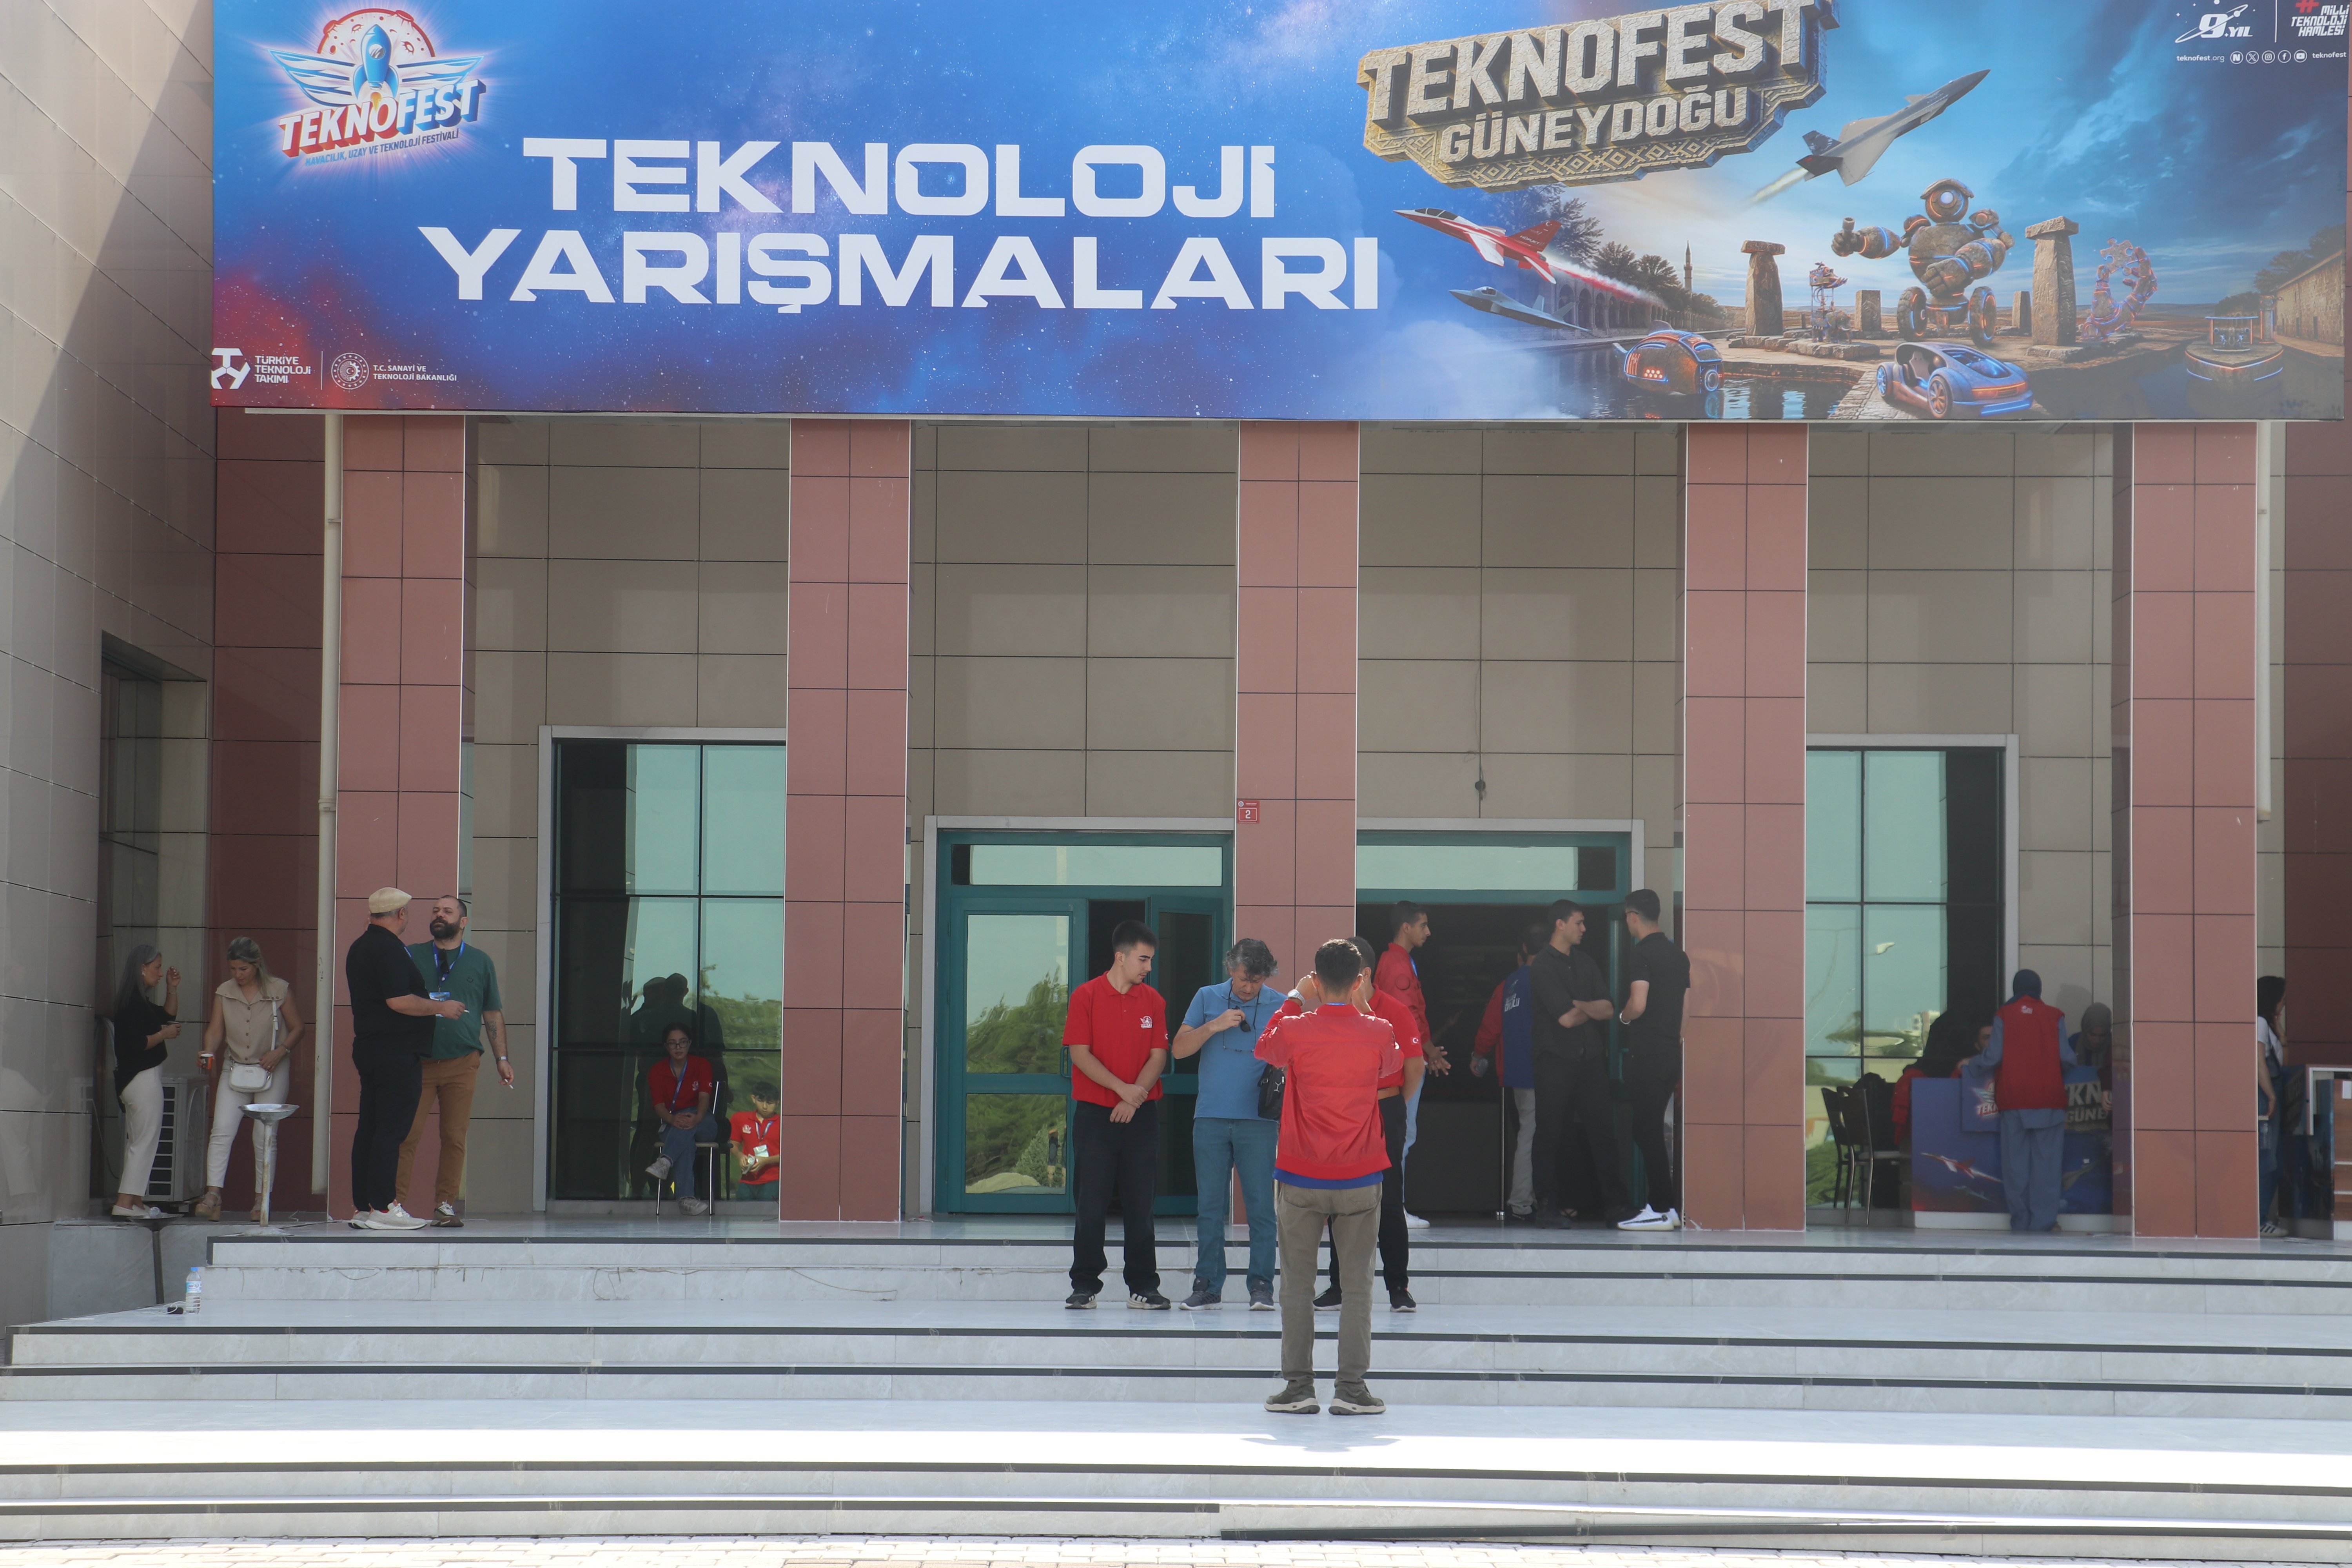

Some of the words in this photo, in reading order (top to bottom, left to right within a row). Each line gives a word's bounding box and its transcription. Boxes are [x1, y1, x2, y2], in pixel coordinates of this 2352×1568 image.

[2291, 15, 2348, 27] TEKNOLOJİ
[2298, 25, 2345, 36] HAMLESİ
[1363, 0, 1817, 122] TEKNOFEST
[2176, 54, 2225, 63] teknofest.org
[279, 80, 485, 156] TEKNOFEST
[1439, 85, 1749, 163] GÜNEYDOĞU
[348, 147, 367, 158] UZAY
[368, 145, 379, 154] VE
[380, 139, 420, 152] TEKNOLOJİ
[421, 128, 459, 145] FESTİVALİ
[418, 226, 1378, 313] YARIŞMALARI
[255, 356, 299, 365] TÜRKİYE
[255, 365, 311, 374] TEKNOLOJİ
[255, 374, 289, 383] TAKIMI
[1245, 809, 1251, 819] 2
